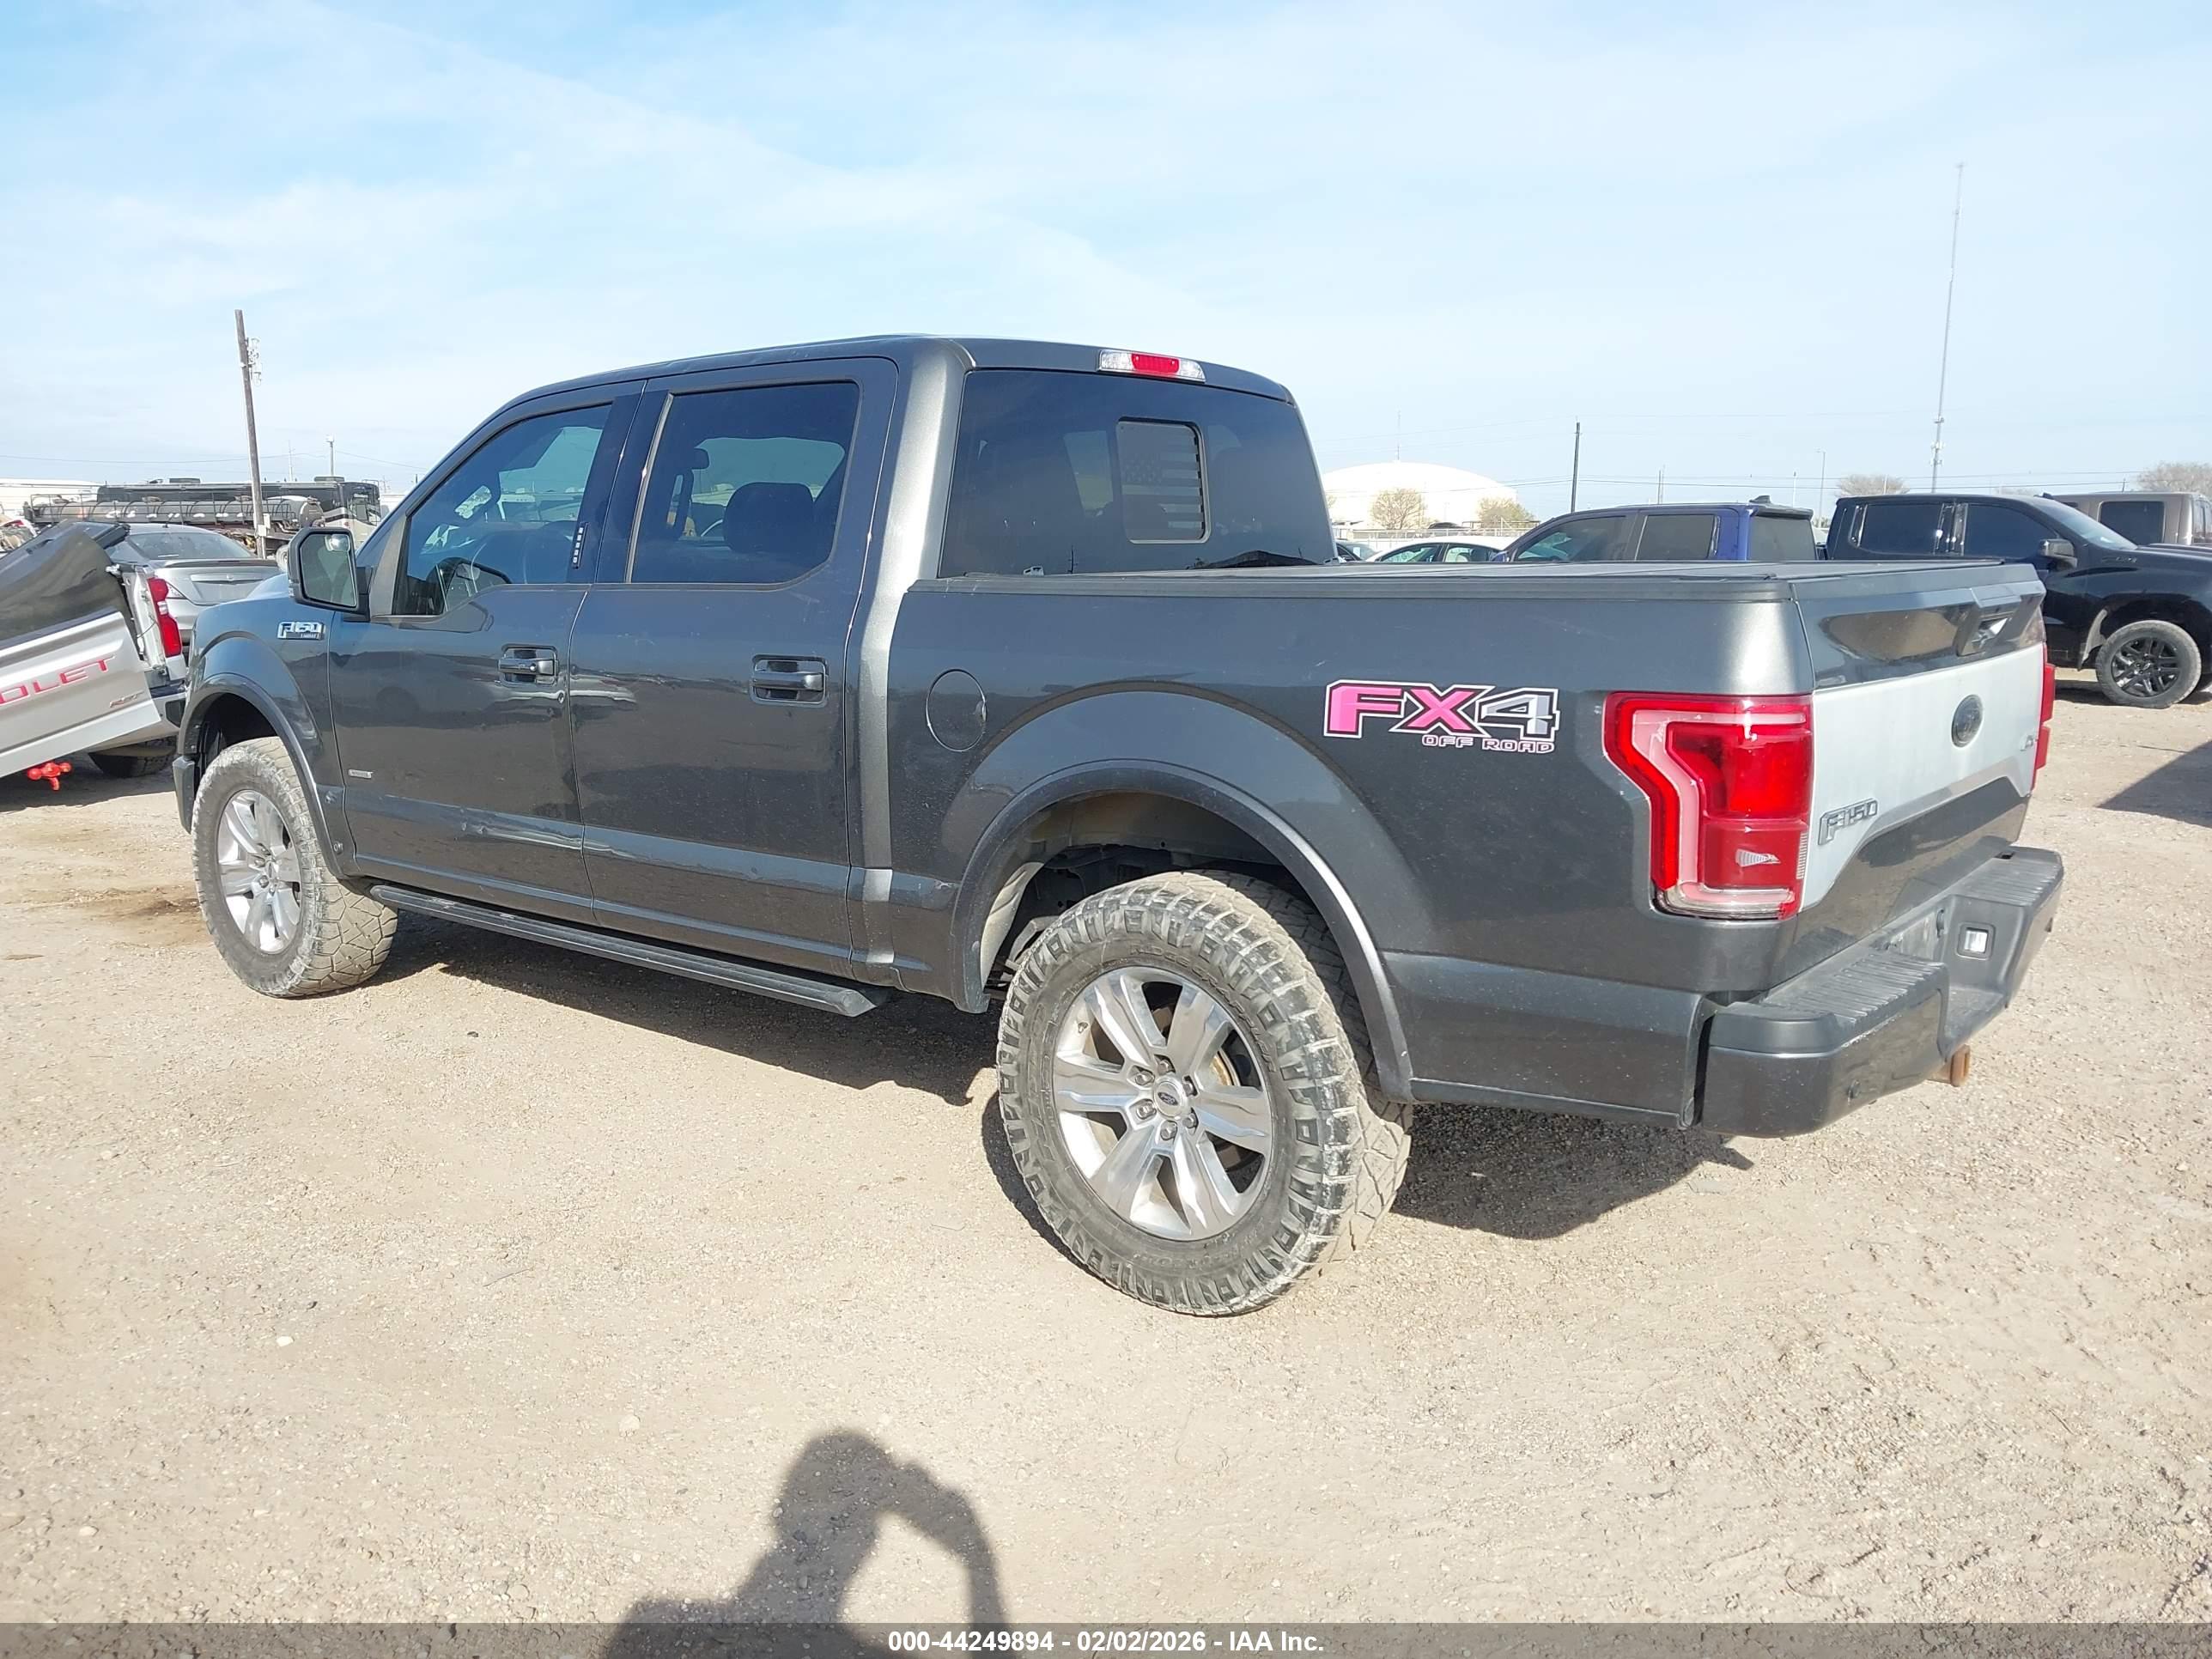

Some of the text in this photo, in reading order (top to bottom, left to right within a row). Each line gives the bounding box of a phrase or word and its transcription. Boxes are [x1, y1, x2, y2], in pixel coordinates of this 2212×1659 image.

[1323, 679, 1560, 742] FX4
[1421, 734, 1555, 754] OFF ROAD
